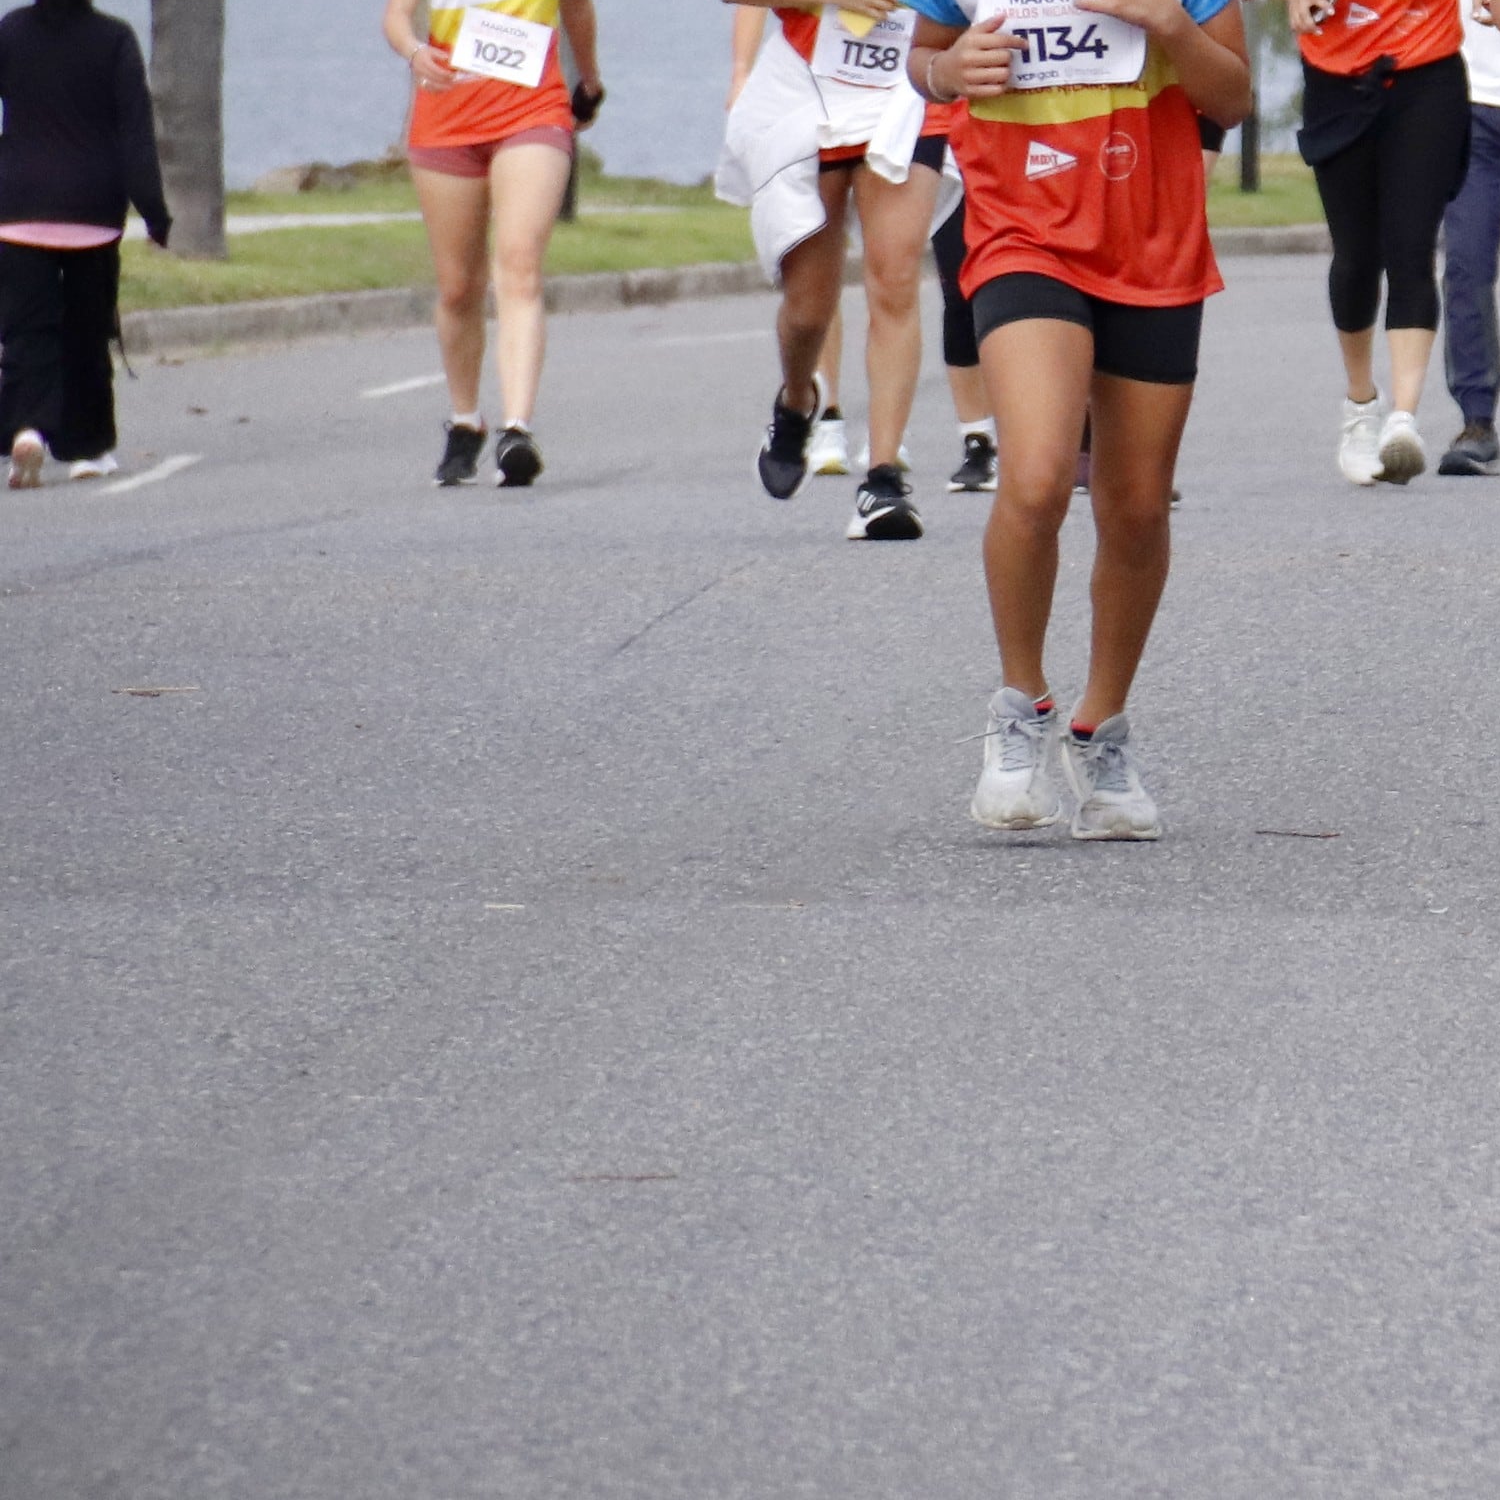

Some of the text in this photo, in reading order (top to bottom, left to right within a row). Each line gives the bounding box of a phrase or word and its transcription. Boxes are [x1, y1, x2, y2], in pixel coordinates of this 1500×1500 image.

[475, 39, 527, 71] 1022
[843, 39, 901, 72] 1138
[1012, 23, 1109, 64] 1134
